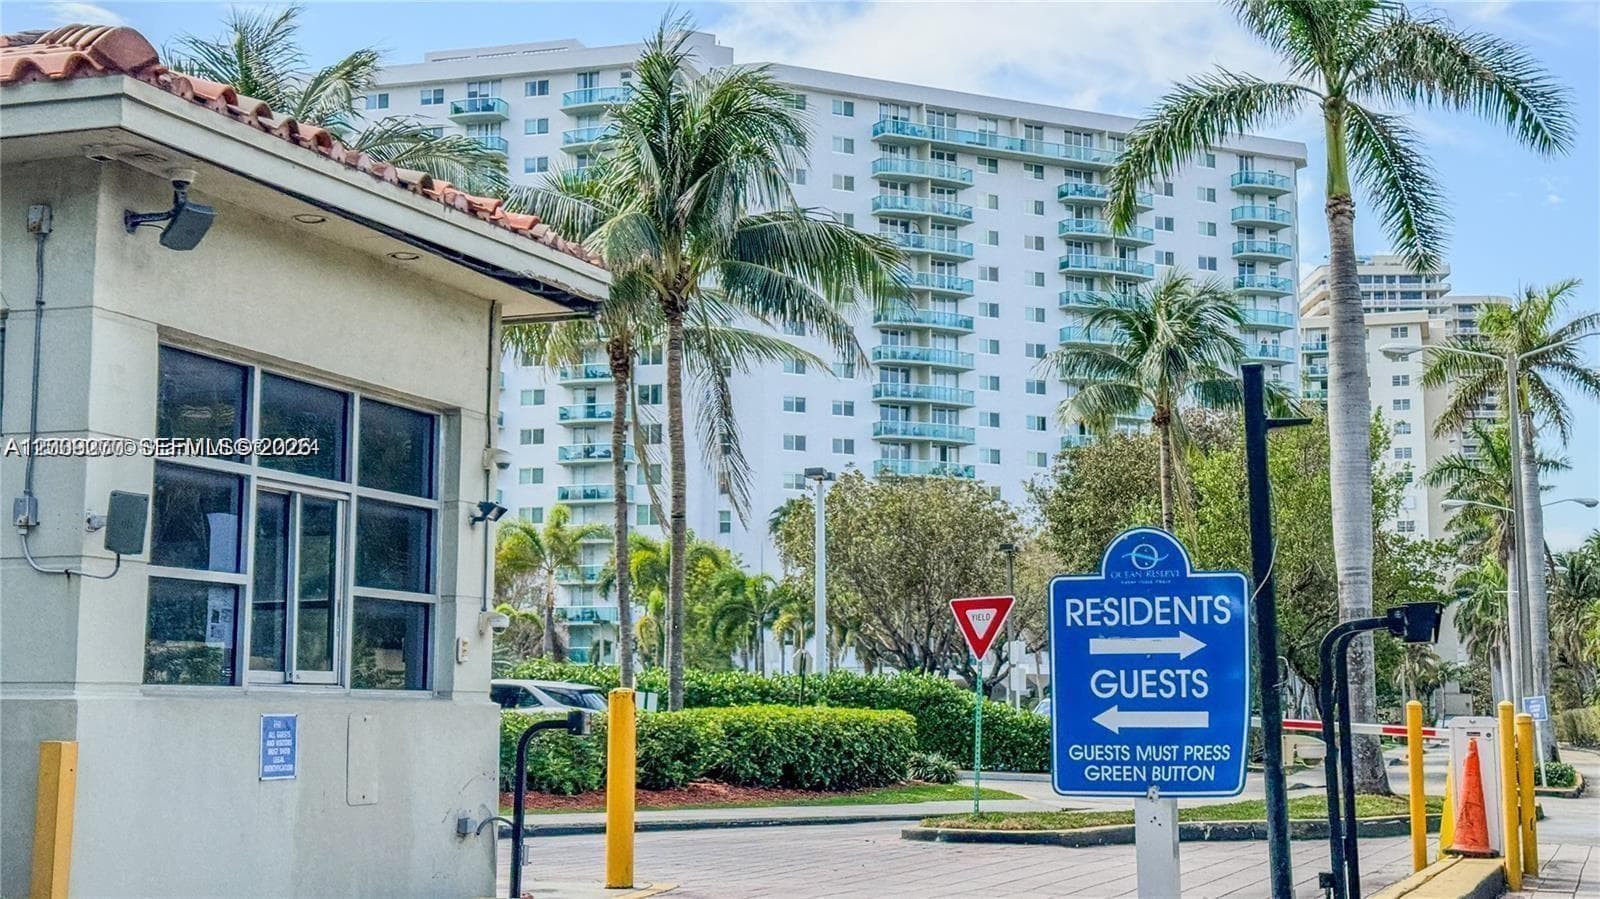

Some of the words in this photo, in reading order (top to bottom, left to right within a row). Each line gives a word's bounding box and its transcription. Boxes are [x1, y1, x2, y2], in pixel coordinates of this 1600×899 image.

[972, 613, 991, 622] YIELD
[1066, 595, 1232, 626] RESIDENTS
[1090, 669, 1209, 699] GUESTS
[1068, 744, 1130, 761] GUESTS
[1136, 744, 1177, 761] MUST
[1184, 744, 1231, 761] PRESS
[1084, 765, 1147, 782] GREEN
[1152, 765, 1216, 782] BUTTON
